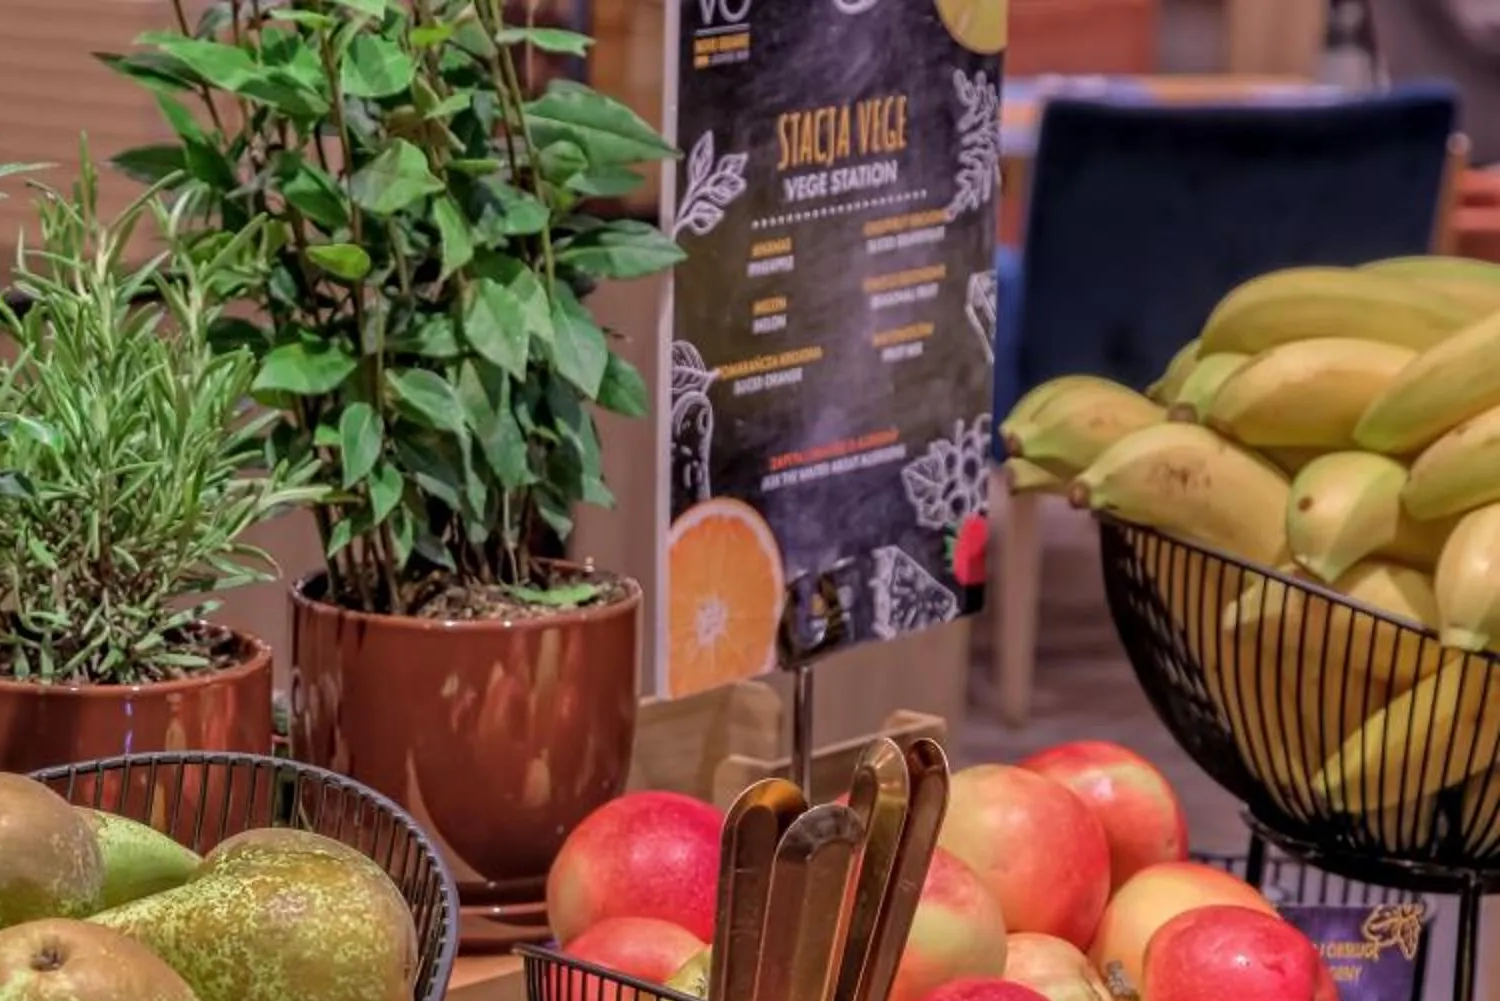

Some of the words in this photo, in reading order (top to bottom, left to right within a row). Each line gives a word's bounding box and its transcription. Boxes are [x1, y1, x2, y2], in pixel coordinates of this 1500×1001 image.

[777, 104, 850, 171] STACJA
[856, 95, 908, 155] VEGE
[784, 171, 828, 202] VEGE
[830, 159, 899, 195] STATION
